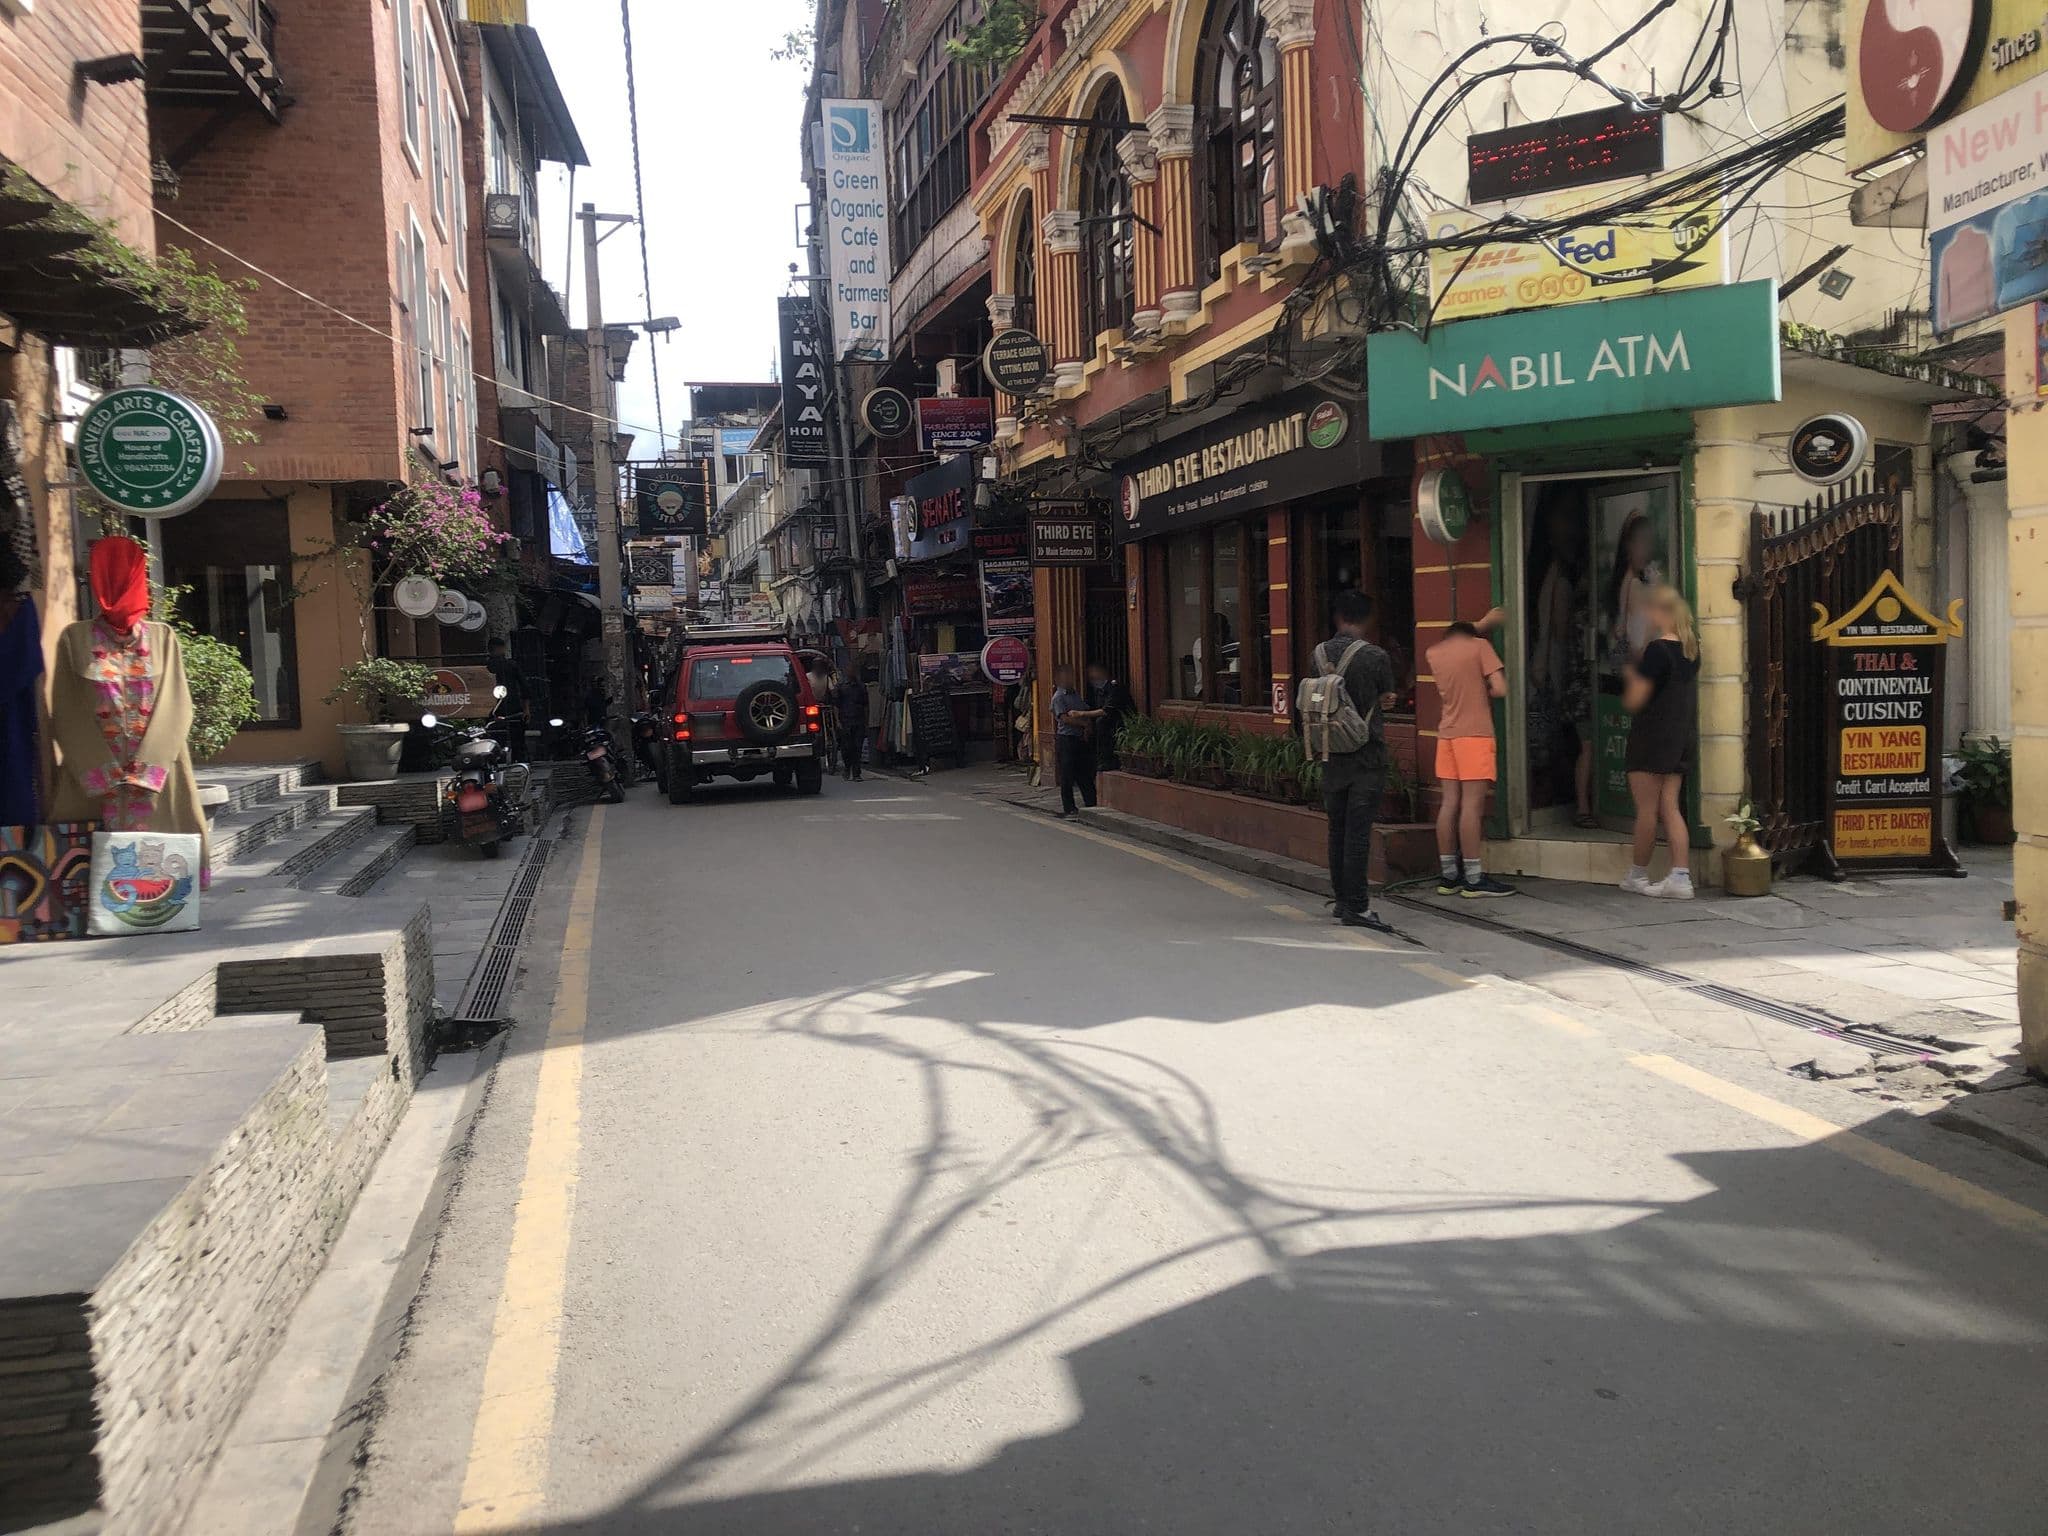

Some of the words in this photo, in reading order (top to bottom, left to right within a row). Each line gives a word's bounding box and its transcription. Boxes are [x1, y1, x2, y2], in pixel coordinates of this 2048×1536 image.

[1992, 29, 2040, 72] Since
[1943, 111, 2021, 176] New
[833, 170, 878, 190] Green
[1943, 161, 2037, 214] Manufacturer,
[831, 198, 884, 224] Organic
[841, 227, 878, 247] Café
[1558, 230, 1617, 267] Fed
[850, 256, 875, 274] and
[1452, 247, 1525, 273] DHL
[838, 283, 888, 303] Farmers
[1443, 285, 1507, 306] aramex
[850, 311, 877, 330] Bar
[992, 348, 1018, 360] TERRACE
[1019, 345, 1042, 357] GARDEN
[999, 363, 1022, 375] SITTING
[1022, 361, 1040, 372] ROOM
[1430, 351, 1575, 400] NABIL
[1588, 330, 1691, 382] ATM
[84, 408, 112, 465] NAVED
[113, 396, 153, 414] ARTS
[156, 401, 169, 414] &
[170, 410, 201, 464] CRAFTS
[931, 431, 957, 439] SINCE
[1137, 462, 1173, 500] THIRD
[1174, 452, 1202, 489] EYE
[1202, 412, 1305, 479] RESTAURANT
[921, 487, 963, 529] SENATE
[1037, 525, 1069, 540] THIRD
[1072, 525, 1093, 540] EYE
[1045, 547, 1058, 556] Main
[1059, 546, 1083, 556] Entrance
[1847, 626, 1858, 634] YIN
[1860, 626, 1878, 634] YANG
[1881, 625, 1928, 634] RESTAURANT
[1855, 653, 1896, 671] THAI
[1900, 653, 1918, 671] &
[1838, 677, 1932, 696] CONTINENTAL
[1844, 701, 1923, 720] CUISINE
[1847, 732, 1872, 749] YIN
[1879, 730, 1921, 747] YANG
[1843, 752, 1921, 770] RESTAURANT
[1836, 779, 1862, 795] Credit
[1866, 779, 1887, 794] Card
[1888, 778, 1930, 795] Accepted
[1836, 812, 1865, 832] THIRD
[1869, 812, 1888, 831] EYE
[1891, 811, 1930, 831] BAKERY
